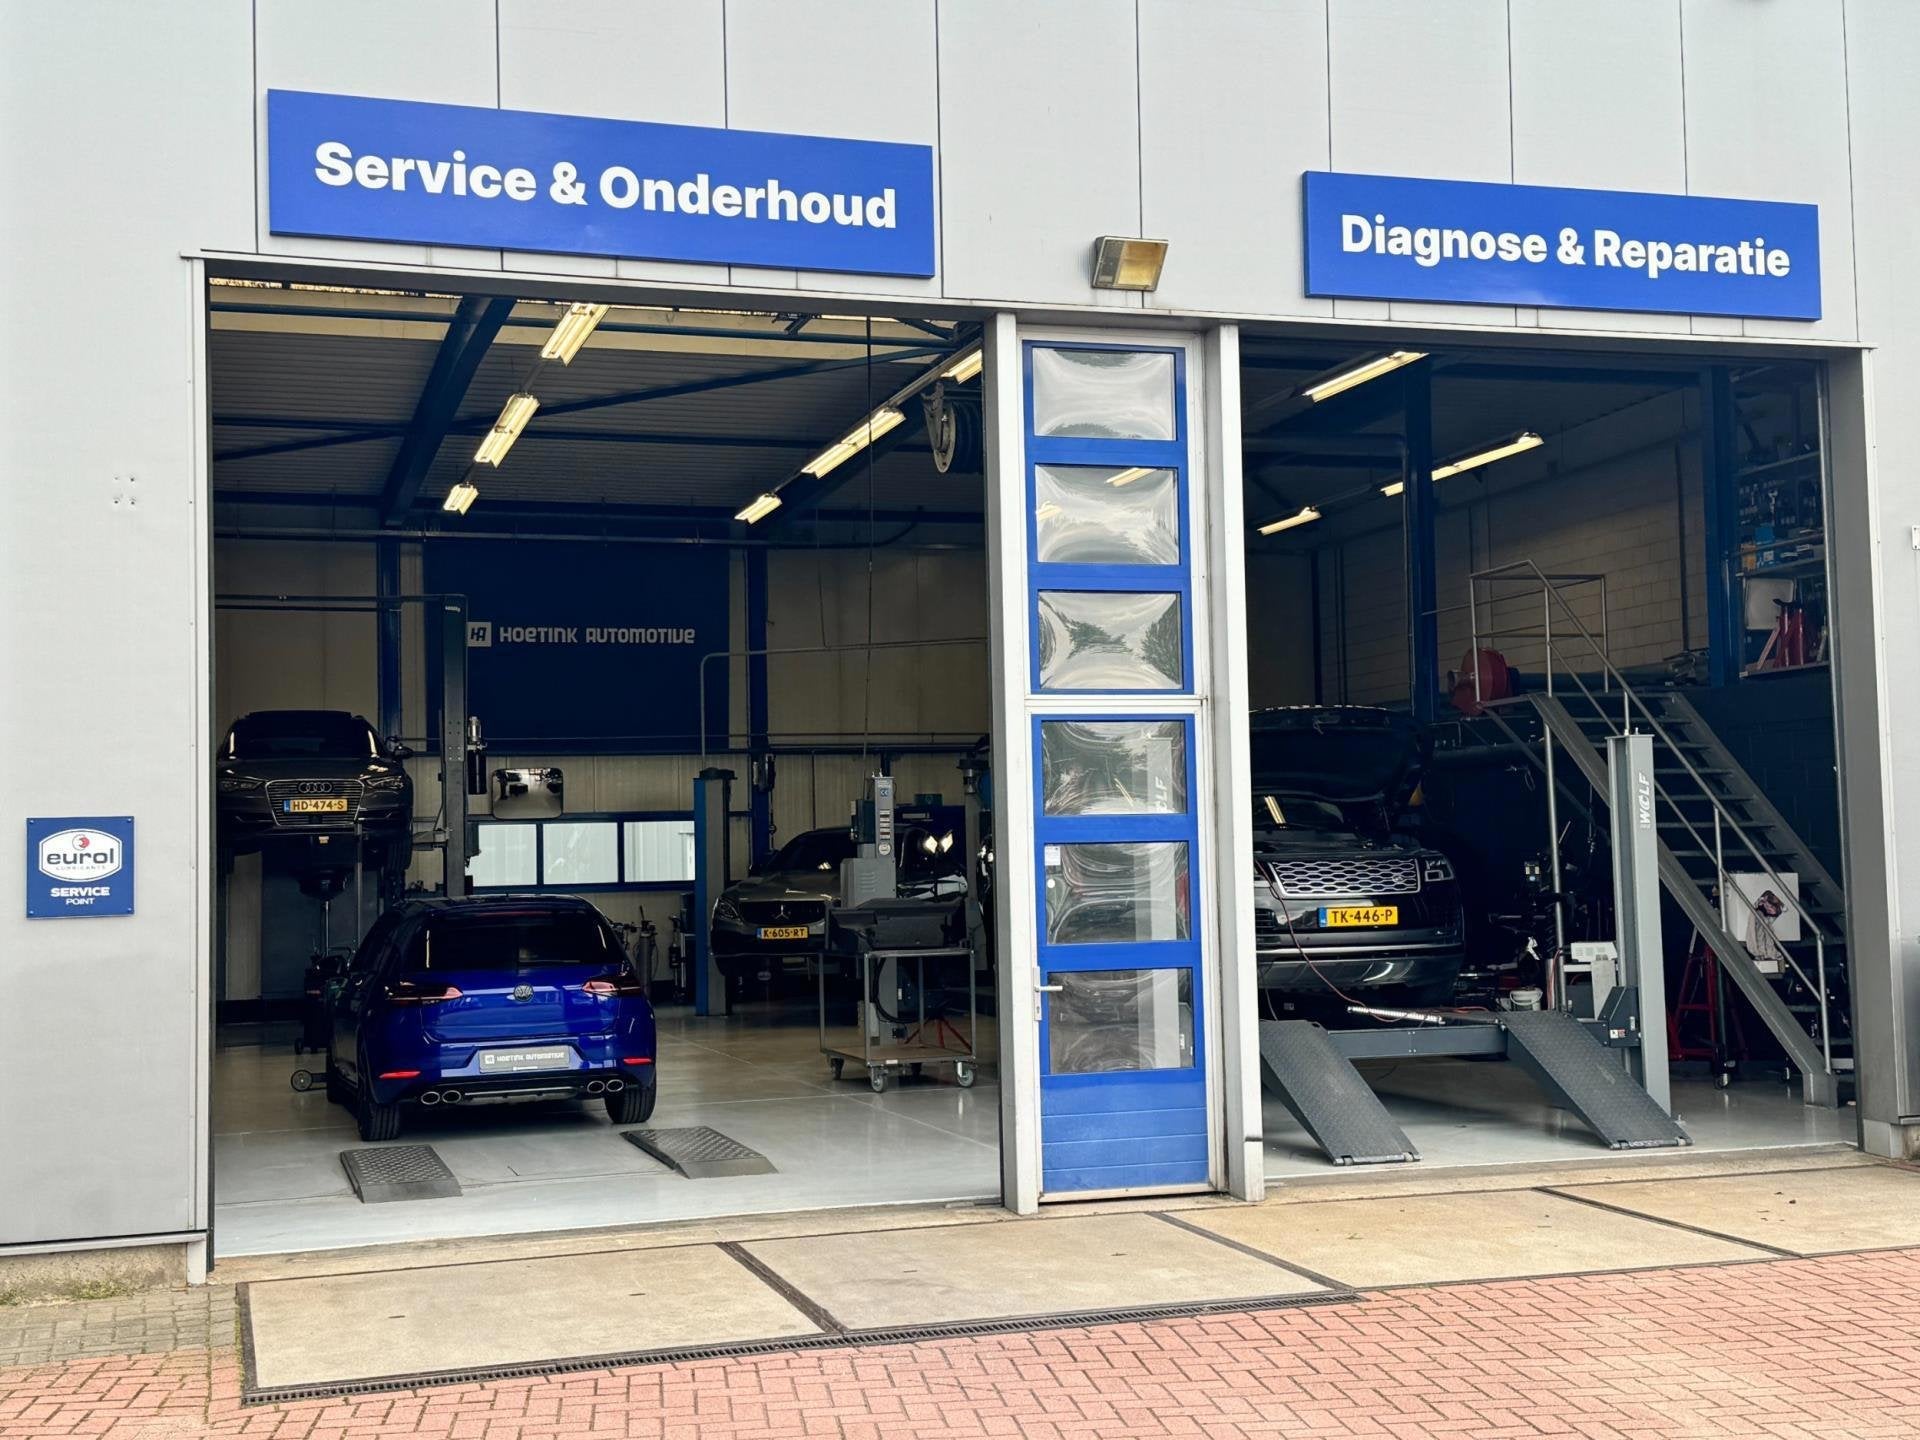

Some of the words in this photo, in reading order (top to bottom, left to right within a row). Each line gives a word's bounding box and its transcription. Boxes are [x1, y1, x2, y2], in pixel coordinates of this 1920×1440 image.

[315, 141, 537, 201] Service
[549, 161, 588, 206] &
[600, 165, 897, 229] Onderhoud
[1341, 213, 1547, 267] Diagnose
[1556, 227, 1586, 266] &
[1594, 229, 1791, 279] Reparatie
[499, 626, 578, 643] HOETINK
[586, 628, 696, 644] AUTOMOTIVE
[292, 800, 344, 811] HD-474-S
[46, 847, 114, 865] eurol
[50, 886, 110, 898] SERVICE
[65, 897, 95, 906] POINT
[1331, 909, 1393, 923] TK-446-P
[763, 928, 805, 938] K-605-RT
